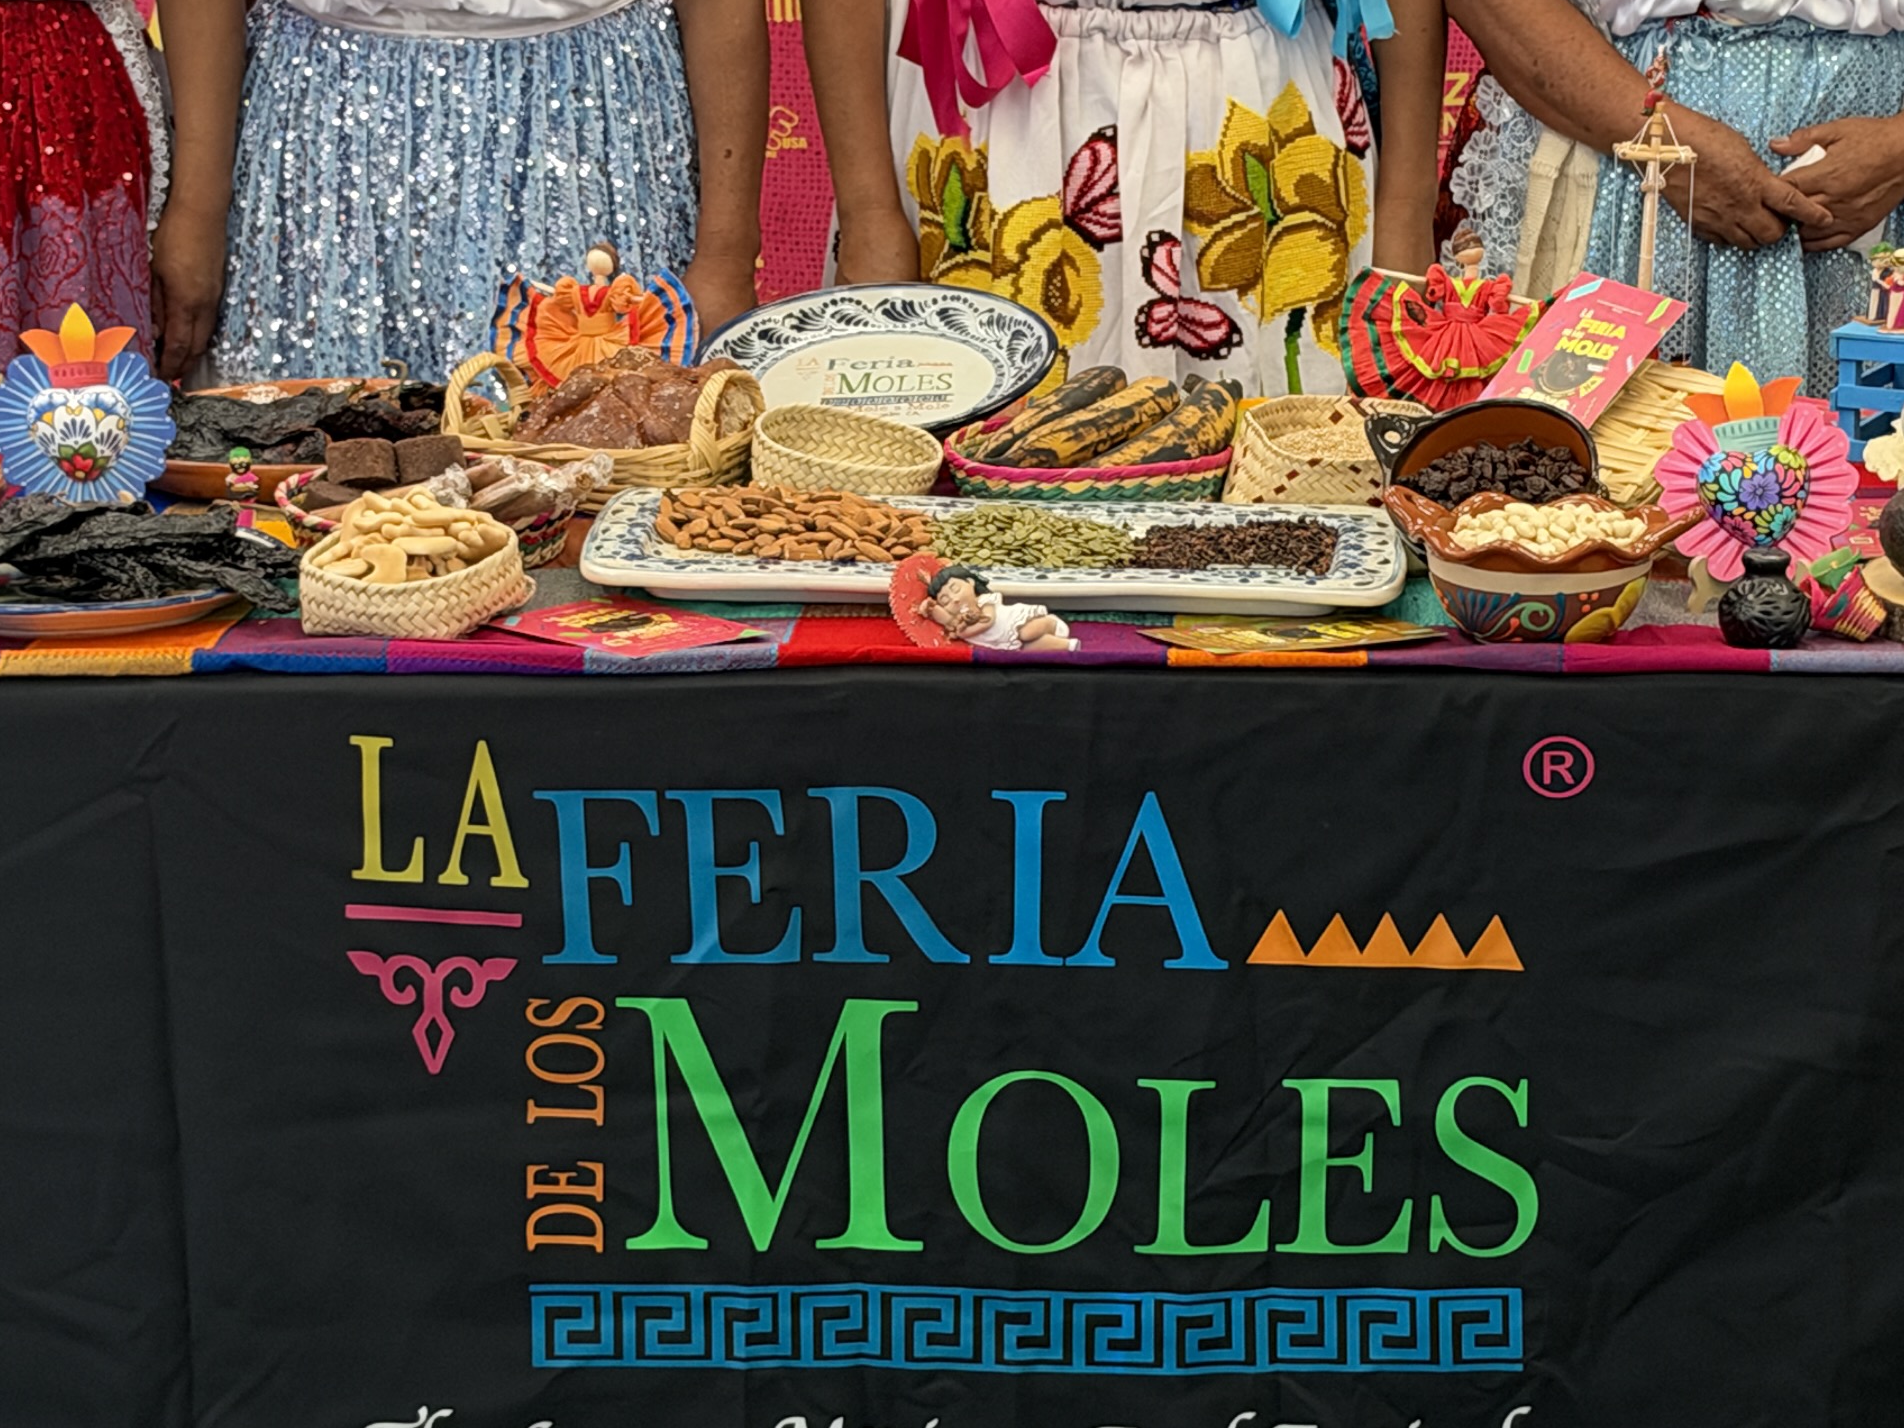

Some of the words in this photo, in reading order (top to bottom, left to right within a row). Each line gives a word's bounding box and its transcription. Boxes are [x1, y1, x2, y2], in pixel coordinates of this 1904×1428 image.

[827, 356, 915, 371] Feria
[836, 372, 953, 395] MOLES
[349, 734, 529, 889] LA
[531, 785, 1230, 970] FERIA
[526, 996, 606, 1127] LOS
[615, 996, 1541, 1258] MOLES
[526, 1161, 605, 1253] DE
